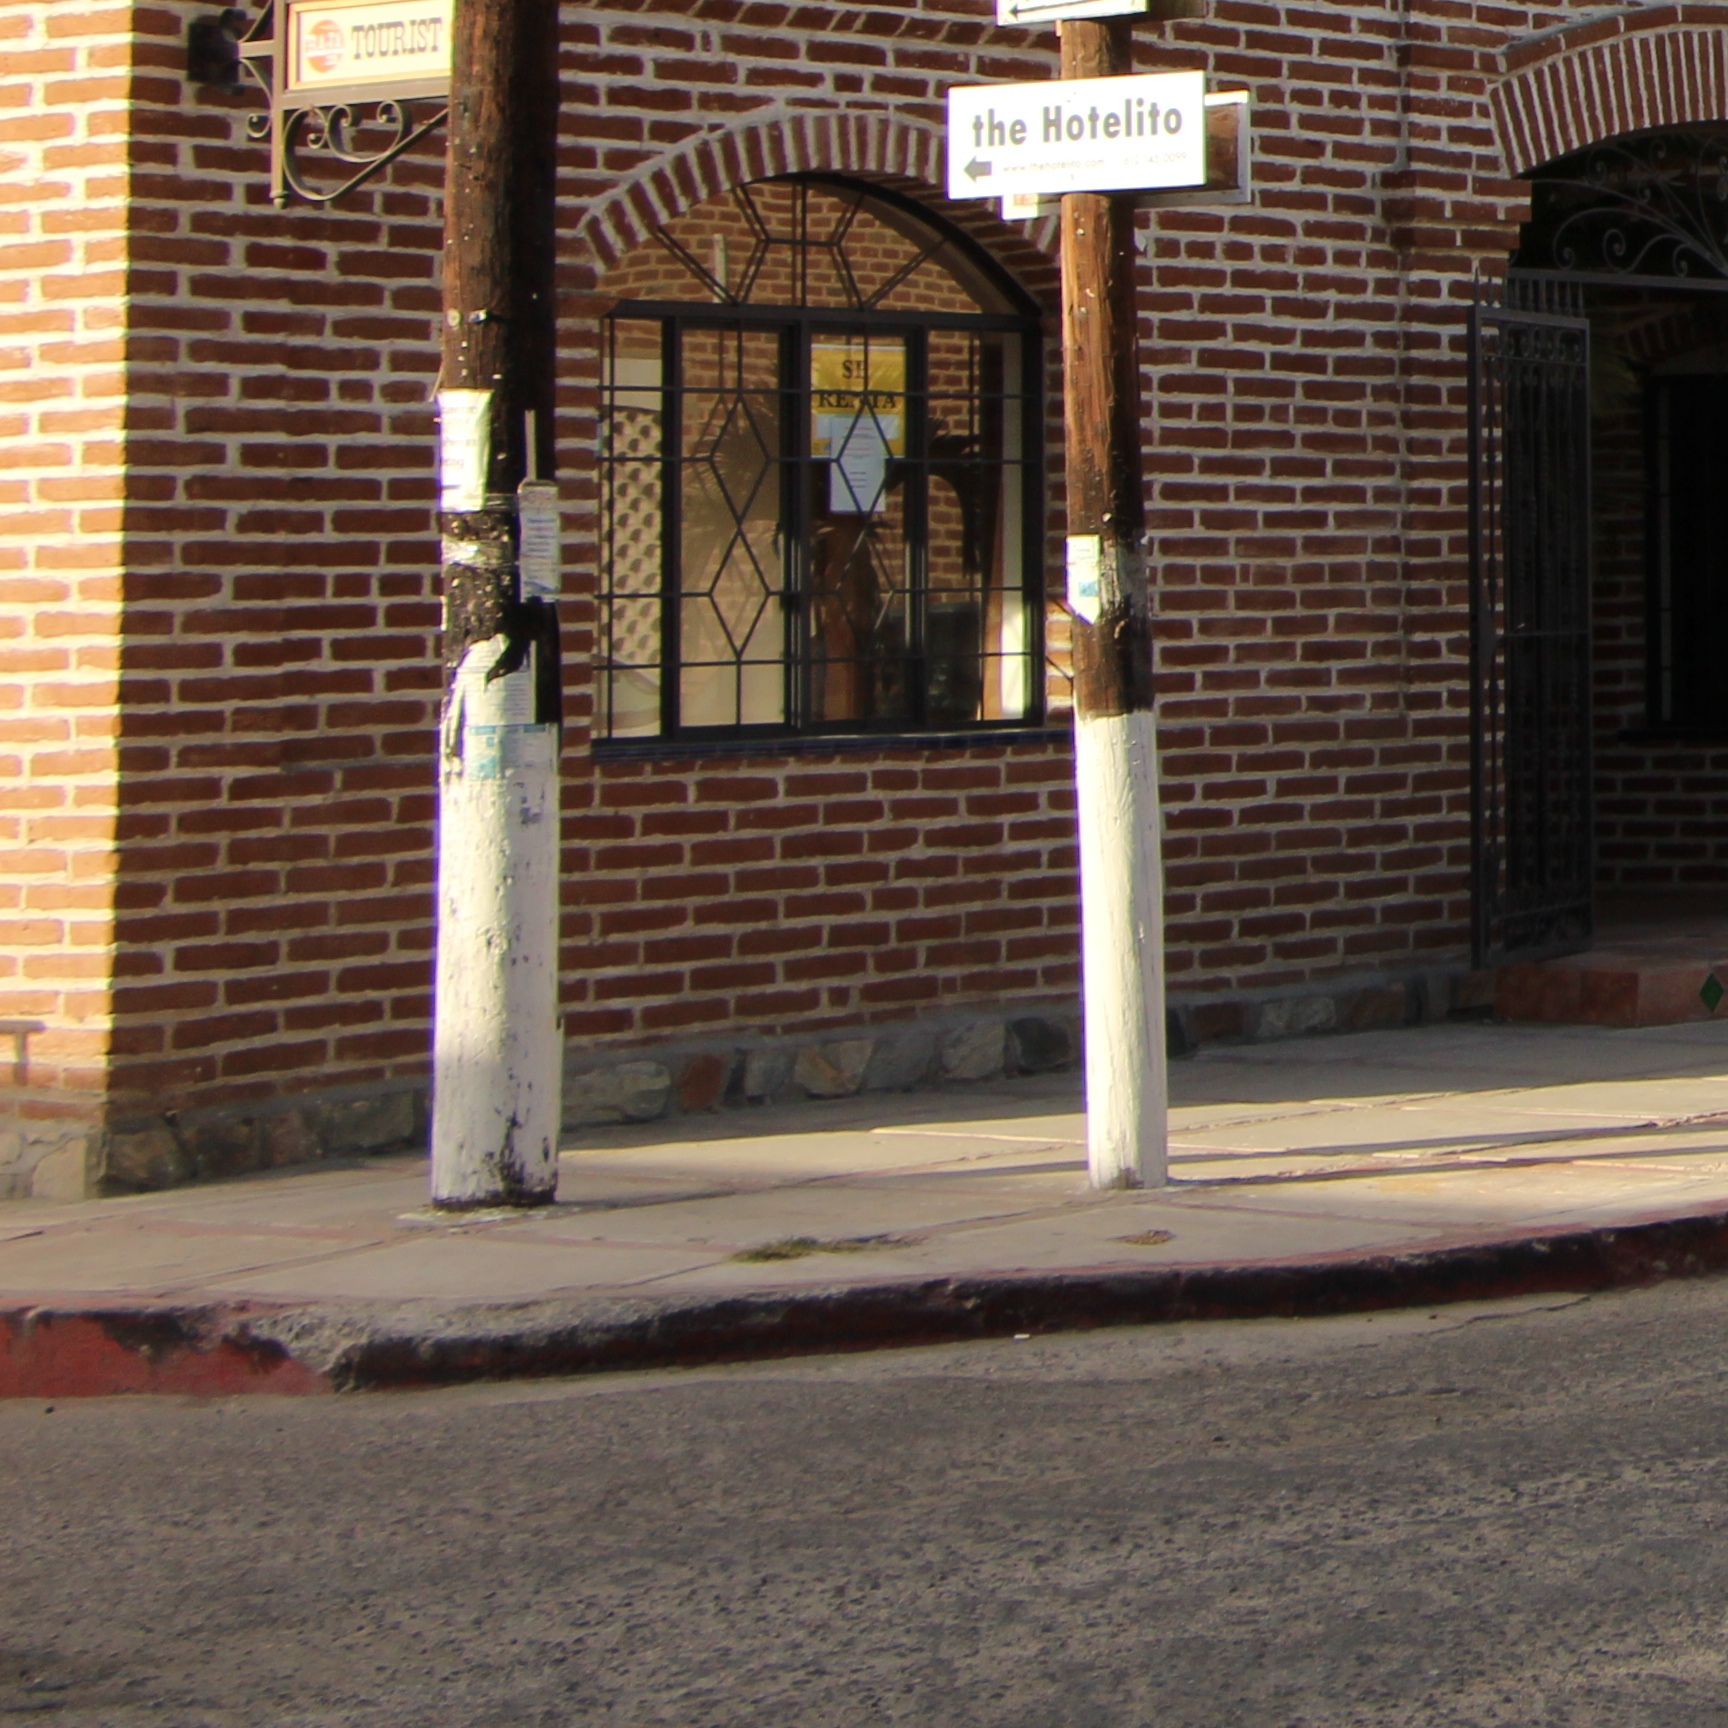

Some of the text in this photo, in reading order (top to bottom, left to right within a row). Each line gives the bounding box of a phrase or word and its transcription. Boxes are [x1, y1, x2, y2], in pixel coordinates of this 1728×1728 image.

[351, 17, 443, 60] TOURIST
[972, 97, 1183, 148] the Hotelito
